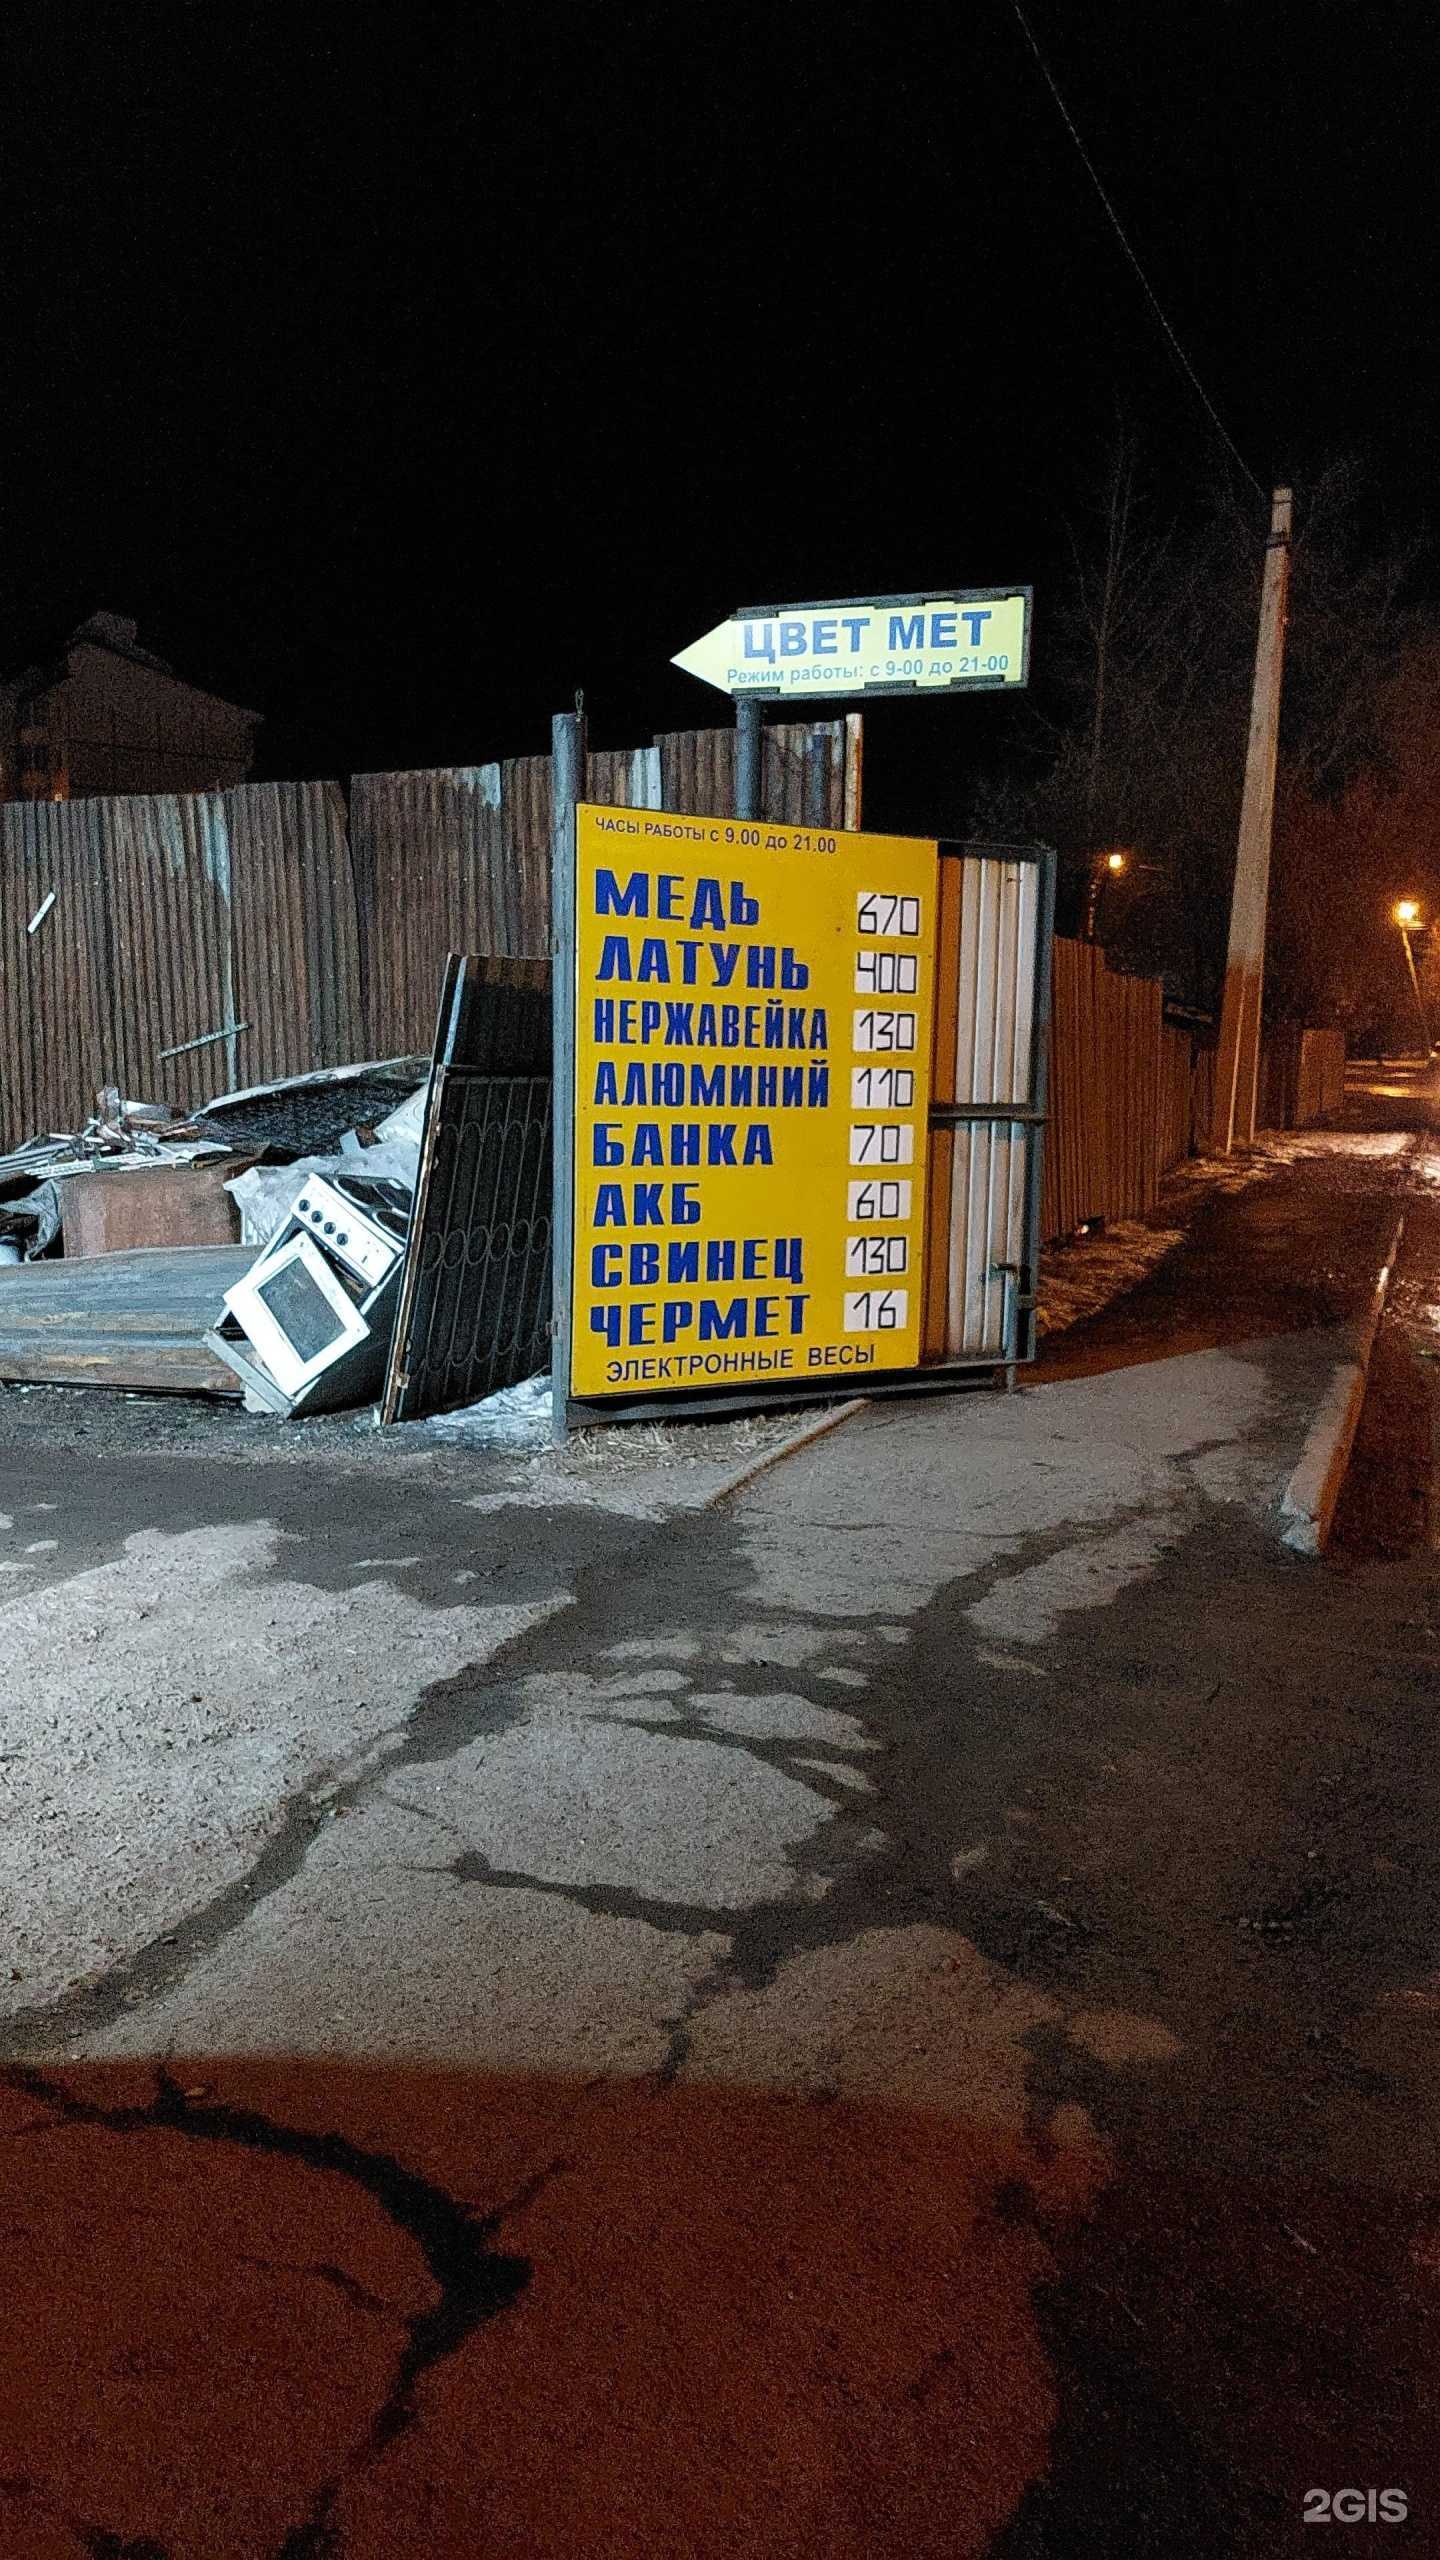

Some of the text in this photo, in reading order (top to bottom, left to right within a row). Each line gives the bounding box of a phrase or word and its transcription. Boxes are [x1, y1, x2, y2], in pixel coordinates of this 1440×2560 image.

[743, 610, 992, 664] ЦВЕТ МЕТ
[727, 666, 784, 684] Режим
[790, 664, 863, 684] работы:
[885, 661, 924, 677] 9-00
[929, 660, 952, 675] до
[959, 655, 1009, 673] 21-00
[595, 817, 639, 834] ЧАСЫ
[645, 823, 704, 841] РАБОТЫ
[724, 827, 760, 847] 9.00
[765, 835, 787, 850] до
[793, 834, 836, 853] 21.00
[595, 869, 759, 931] МЕДЬ
[858, 894, 919, 936] 670
[595, 936, 809, 990] ЛАТУНЬ
[857, 952, 917, 994] 400
[594, 998, 828, 1050] НЕРЖАВЕЙКА
[858, 1011, 916, 1050] 130
[593, 1059, 829, 1108] АЛЮМИНИЙ
[857, 1068, 914, 1107] 110
[592, 1123, 773, 1167] БАНКА
[853, 1125, 900, 1162] 70
[593, 1182, 701, 1227] АКБ
[856, 1182, 899, 1219] 60
[591, 1238, 803, 1288] СВИНЕЦ
[851, 1236, 907, 1273] 130
[590, 1294, 811, 1347] ЧЕРМЕТ
[853, 1291, 896, 1329] 16
[606, 1344, 874, 1382] ЭЛЕКТРОННЫЕ ВЕСЫ
